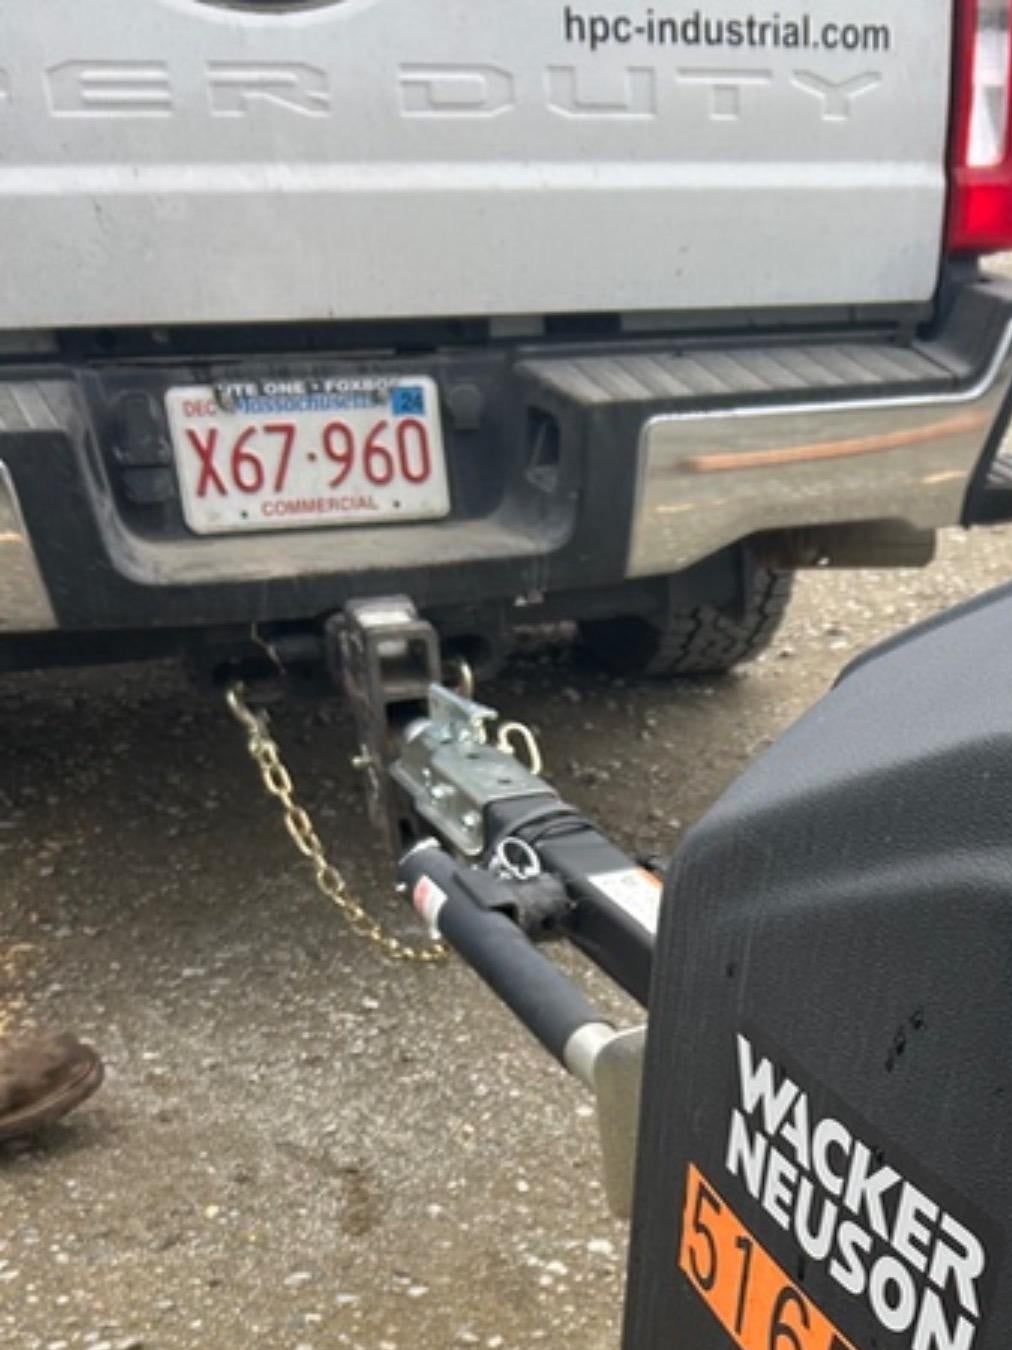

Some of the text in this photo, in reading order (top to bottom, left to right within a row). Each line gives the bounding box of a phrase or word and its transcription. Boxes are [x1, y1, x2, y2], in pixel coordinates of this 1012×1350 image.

[564, 6, 890, 51] hpc-industrial.com
[0, 59, 882, 121] ER DUTY
[261, 496, 379, 516] COMMERCIAL
[736, 1032, 986, 1317] WACKER
